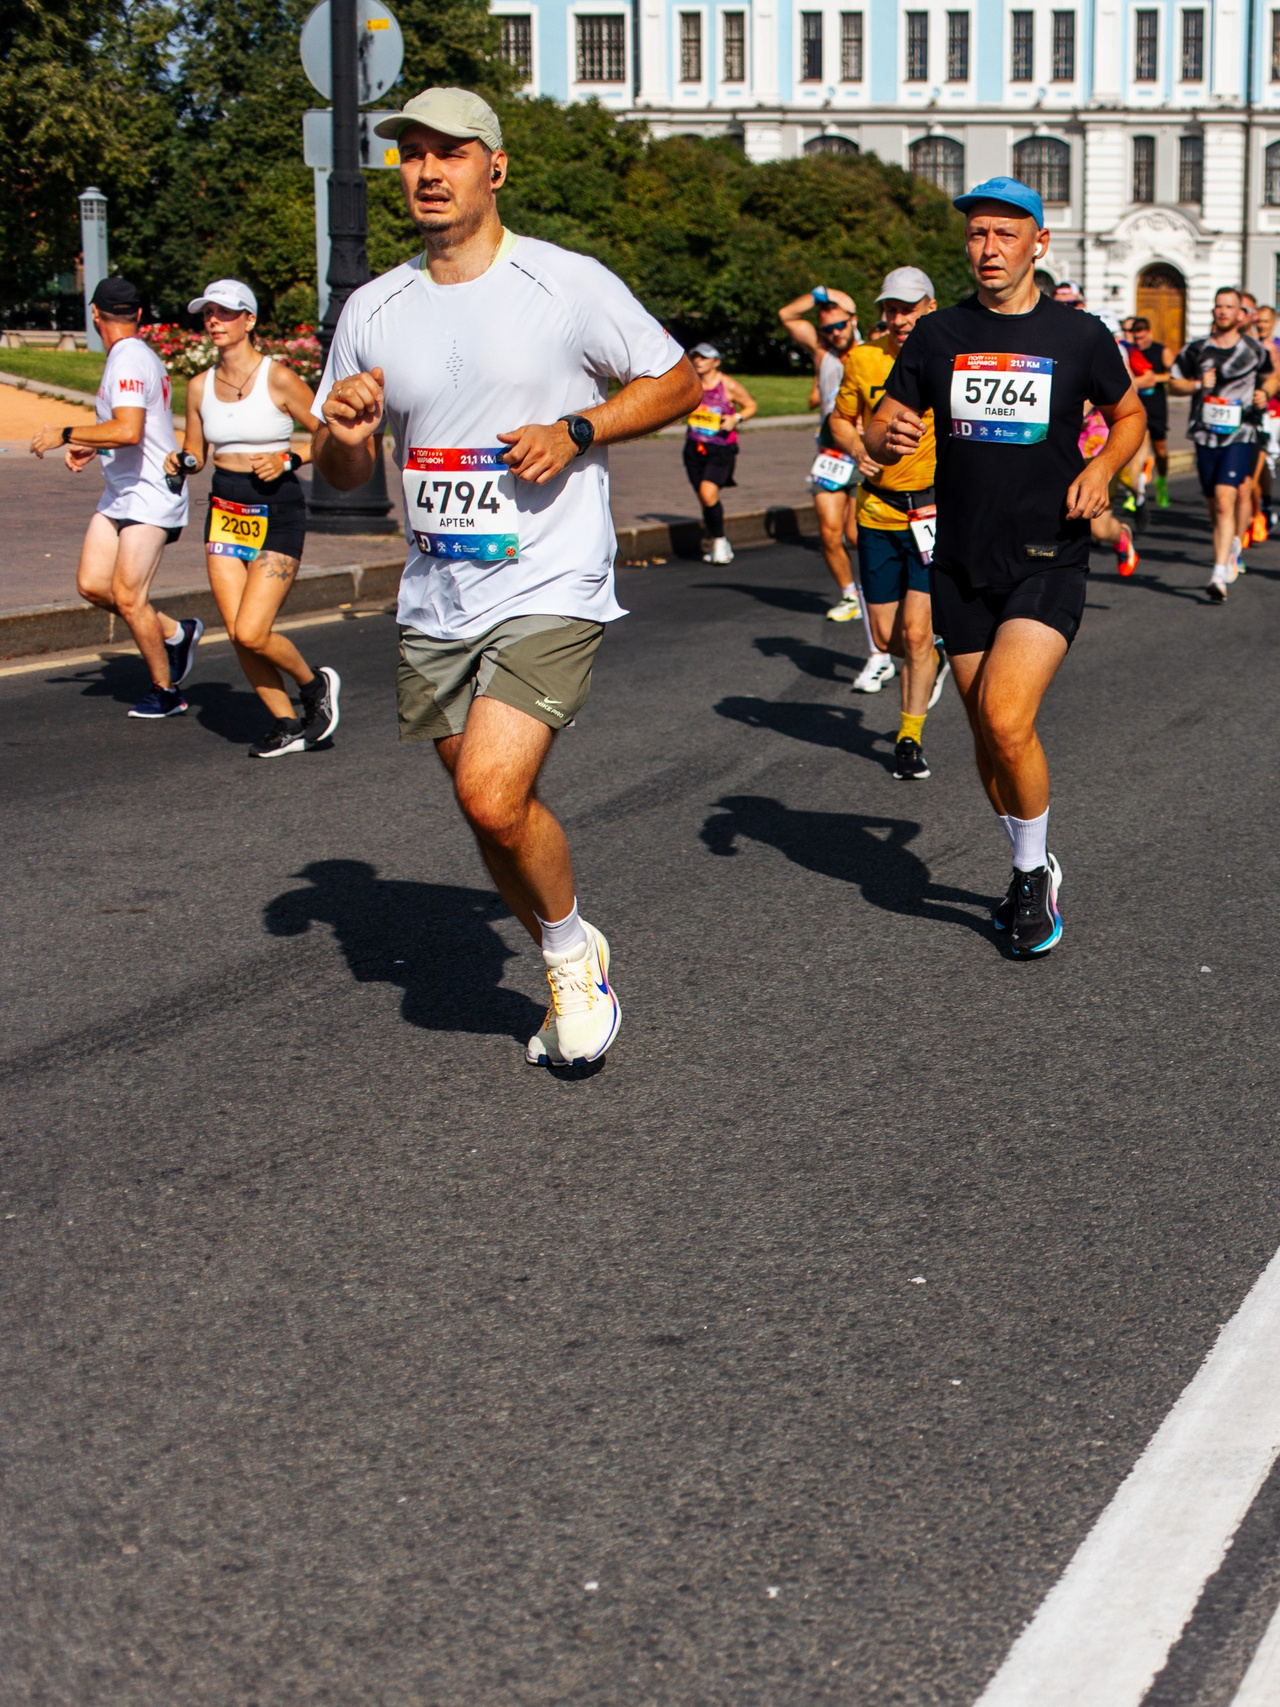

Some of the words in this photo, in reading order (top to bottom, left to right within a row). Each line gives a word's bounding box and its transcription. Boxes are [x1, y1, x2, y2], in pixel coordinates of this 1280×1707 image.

[1010, 359, 1025, 367] 21,1
[965, 377, 1037, 407] 5764
[985, 407, 1015, 416] ПАВЕЛ
[460, 455, 478, 465] 21,1
[416, 481, 501, 514] 4794
[221, 515, 260, 538] 2203
[439, 518, 475, 528] АРТЕМ
[535, 700, 551, 712] NIKE
[551, 709, 564, 719] PRO
